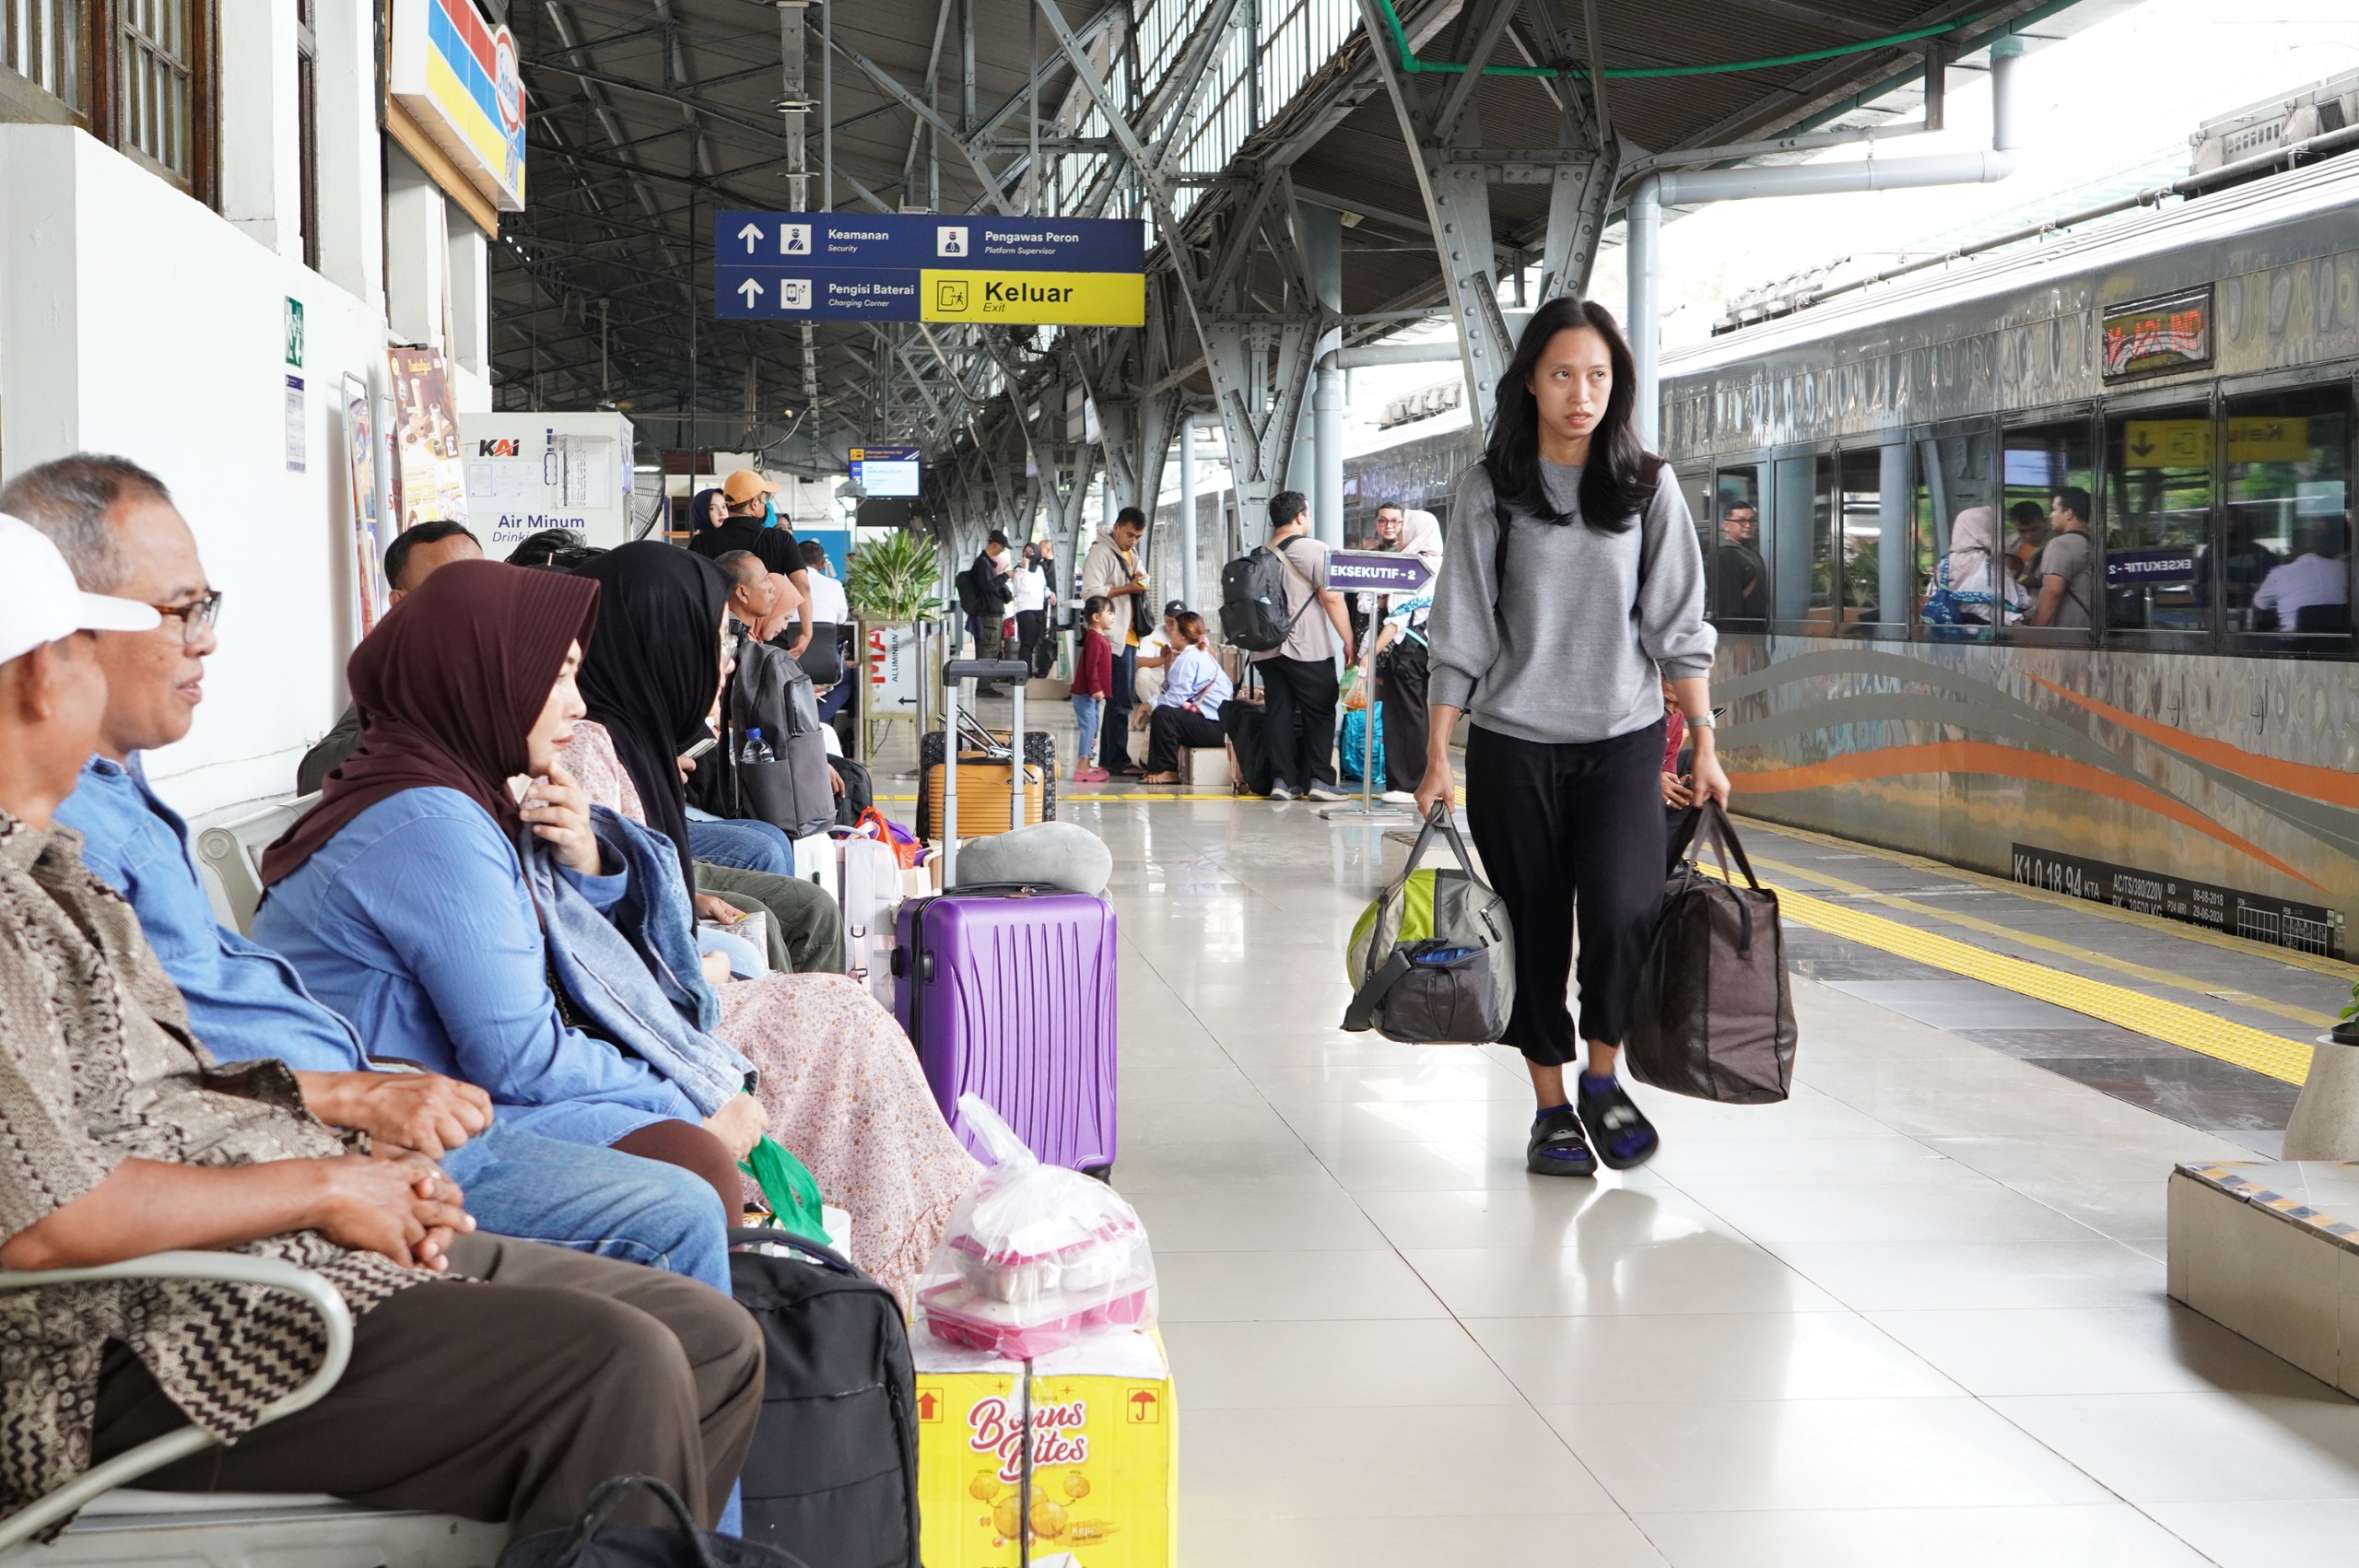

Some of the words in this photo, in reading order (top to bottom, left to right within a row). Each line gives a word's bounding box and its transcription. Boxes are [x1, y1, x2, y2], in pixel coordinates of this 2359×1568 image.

[827, 228, 889, 240] Keamanan
[985, 230, 1043, 244] Pengawas
[1046, 231, 1079, 242] Peron
[827, 244, 858, 253] Security
[984, 246, 1015, 254] Platform
[1016, 247, 1056, 256] Supervisor
[828, 283, 871, 297] Pengisi
[873, 284, 915, 295] Baterai
[985, 281, 1074, 302] Keluar
[827, 298, 863, 309] Charging
[863, 298, 889, 307] Corner
[982, 302, 1005, 312] Exit
[478, 439, 521, 457] KAI
[498, 515, 522, 528] Air
[527, 515, 585, 528] Minum
[1330, 565, 1399, 579] EKSEKUTIF
[1407, 569, 1416, 580] 2
[2014, 853, 2030, 884] K1
[2047, 861, 2061, 893] 18
[2065, 866, 2082, 897] 94
[2083, 880, 2100, 900] KTA
[2112, 873, 2164, 901] AC/TS/380/220V
[2167, 883, 2176, 895] MD
[2193, 888, 2224, 907] 06-08-2018
[2167, 900, 2177, 912] P24
[2193, 905, 2224, 923] 29-06-2024
[998, 1430, 1085, 1482] Bites
[1072, 1525, 1094, 1536] Keju
